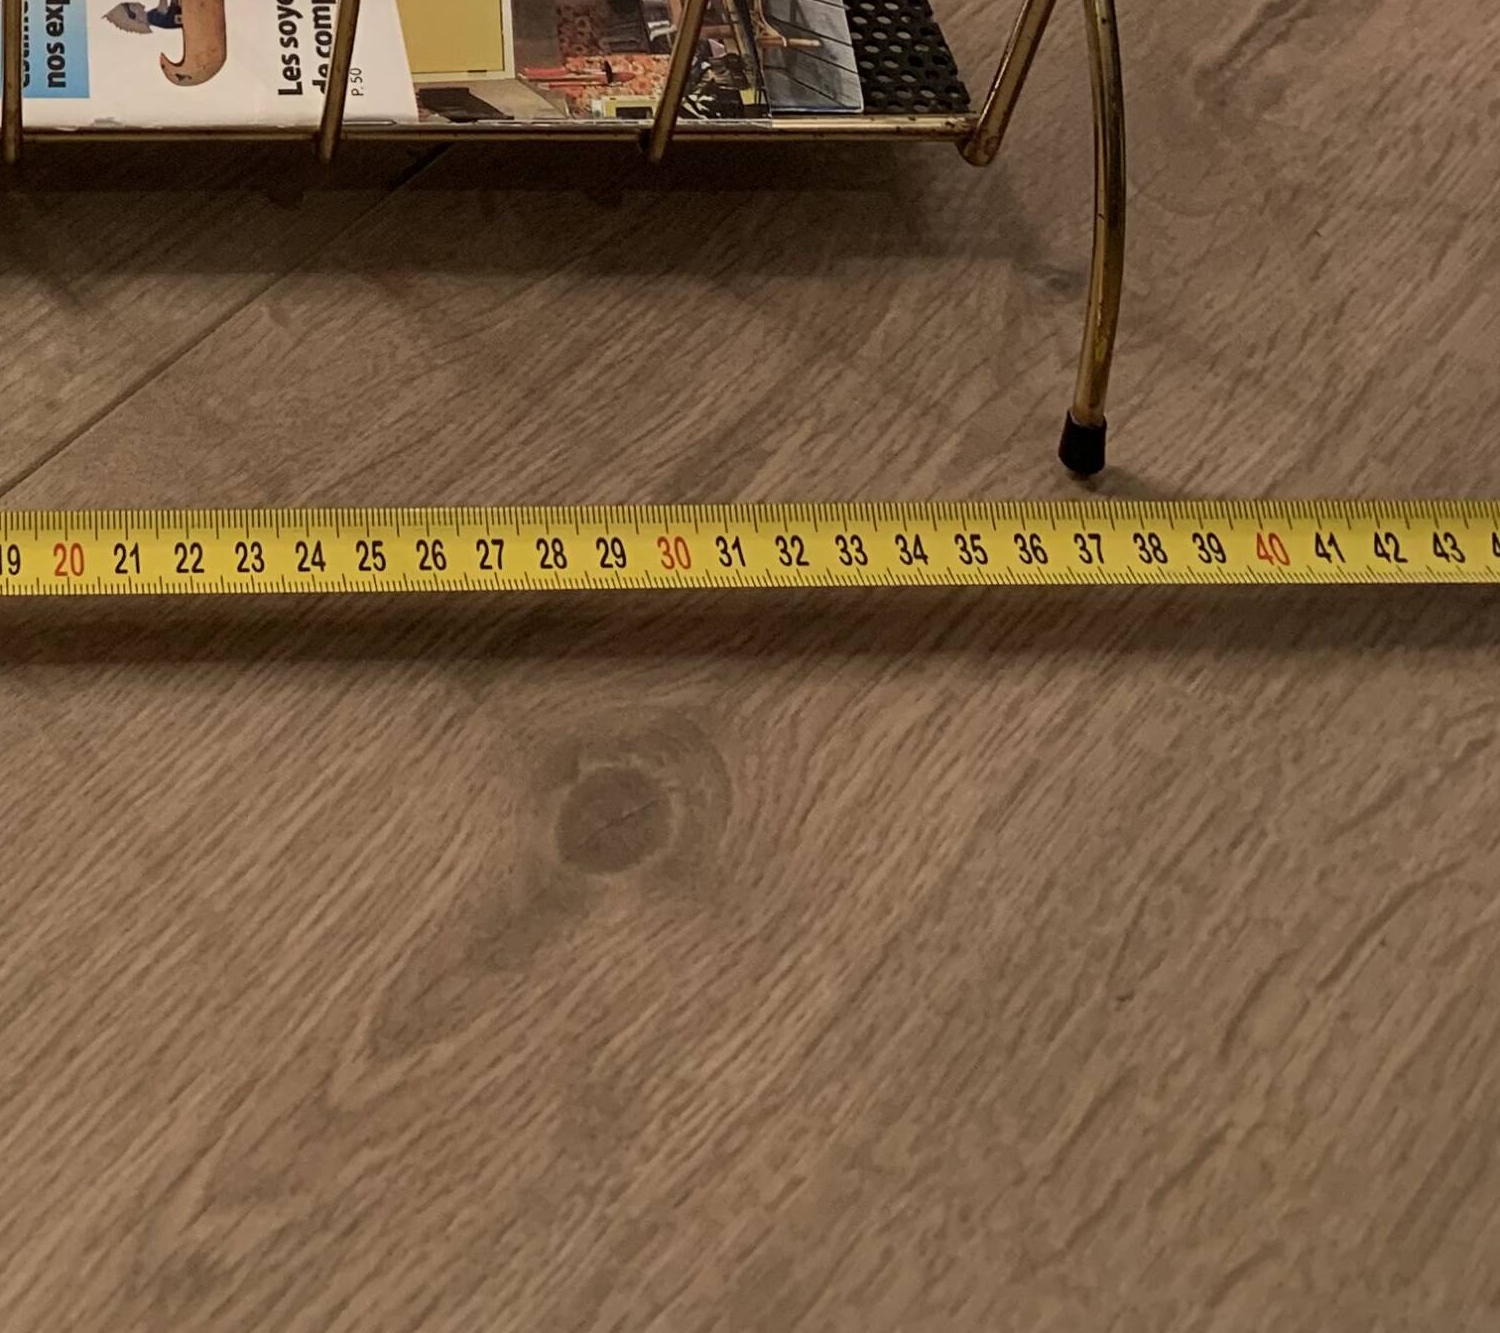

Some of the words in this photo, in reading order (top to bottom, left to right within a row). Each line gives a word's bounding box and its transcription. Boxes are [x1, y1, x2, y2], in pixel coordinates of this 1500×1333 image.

[46, 42, 66, 88] nos
[277, 54, 303, 96] Les
[350, 68, 362, 83] 50
[53, 543, 85, 577] 20
[113, 543, 141, 574] 21
[174, 542, 204, 574] 22
[234, 542, 265, 573] 23
[294, 541, 326, 573] 24
[355, 540, 386, 572] 25
[415, 540, 447, 572] 26
[476, 539, 504, 571] 27
[536, 538, 567, 569] 28
[596, 537, 627, 569] 29
[657, 536, 692, 570] 30
[715, 536, 746, 568] 31
[775, 535, 810, 567] 32
[835, 535, 868, 566] 33
[895, 534, 929, 565] 34
[955, 534, 988, 565] 35
[1013, 533, 1048, 565] 36
[1074, 533, 1104, 564] 37
[1133, 533, 1168, 564] 38
[1192, 533, 1226, 564] 39
[1255, 532, 1290, 565] 40
[1314, 532, 1346, 563] 41
[1373, 532, 1408, 563] 42
[1433, 532, 1465, 563] 43
